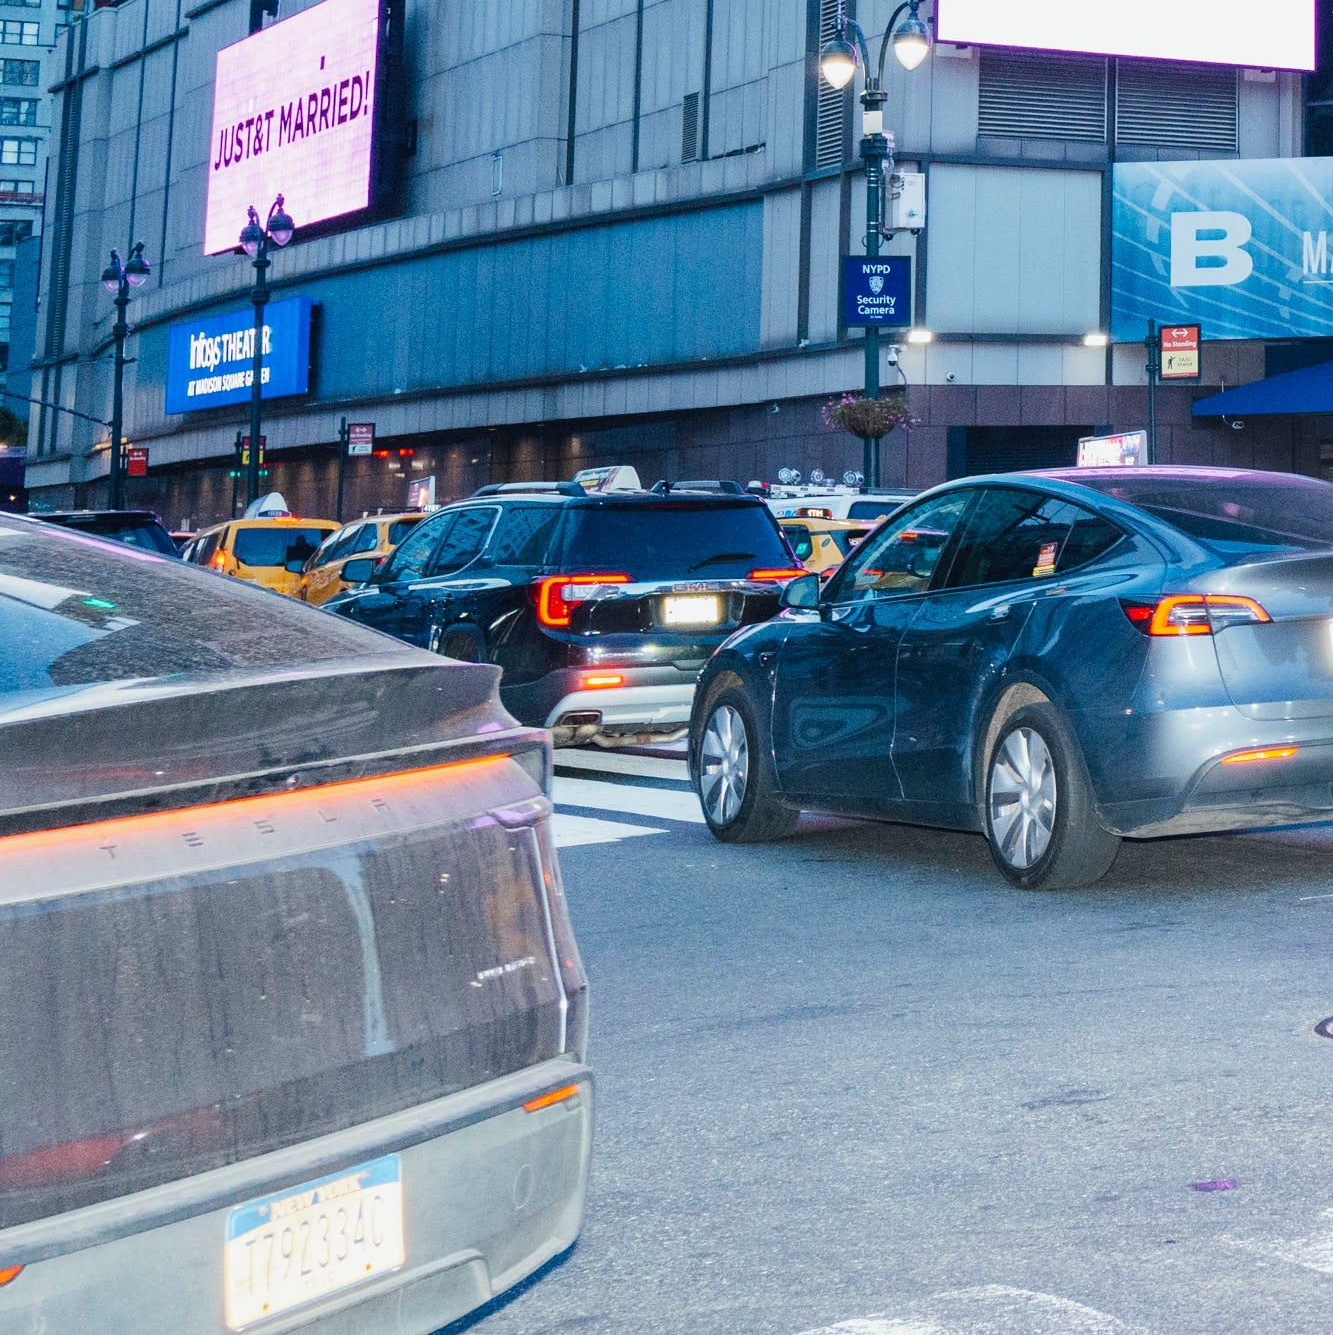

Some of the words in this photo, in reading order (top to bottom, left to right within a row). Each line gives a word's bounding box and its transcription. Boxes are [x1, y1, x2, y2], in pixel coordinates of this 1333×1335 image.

[213, 108, 275, 171] JUST&T
[278, 70, 370, 148] MARRIED!
[1170, 210, 1254, 287] B
[862, 263, 891, 274] NYPD
[856, 294, 897, 307] Security
[857, 305, 895, 315] Camera
[221, 324, 272, 363] THEATR
[671, 582, 721, 593] GMC
[100, 798, 392, 860] TESLA
[244, 1194, 384, 1297] T792334C
